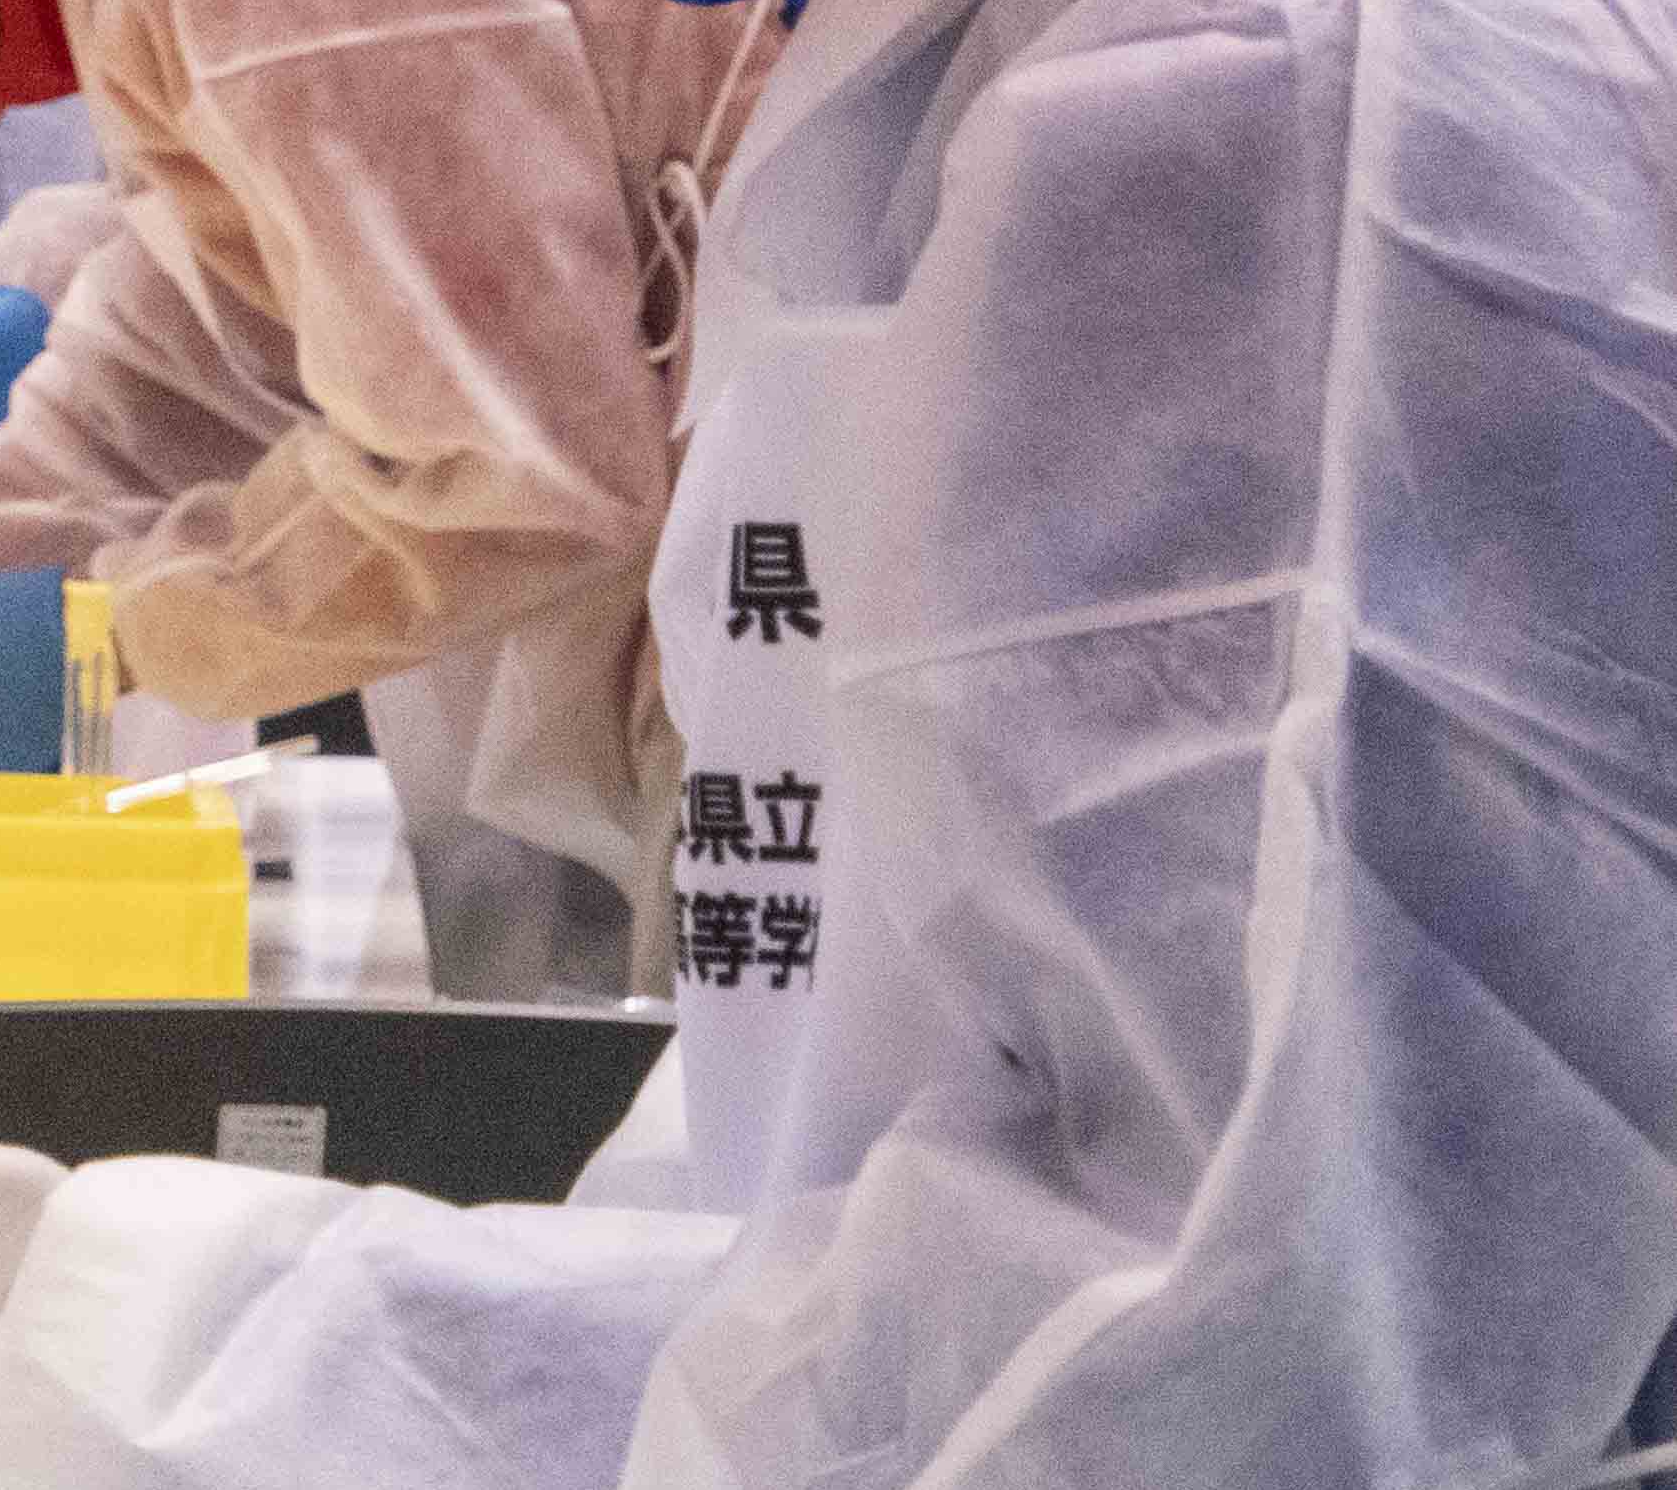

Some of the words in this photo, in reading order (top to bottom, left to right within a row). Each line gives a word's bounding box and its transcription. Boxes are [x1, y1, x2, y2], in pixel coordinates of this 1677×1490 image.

[726, 521, 823, 645] 県
[673, 770, 823, 866] 県立
[673, 890, 822, 991] 等学
